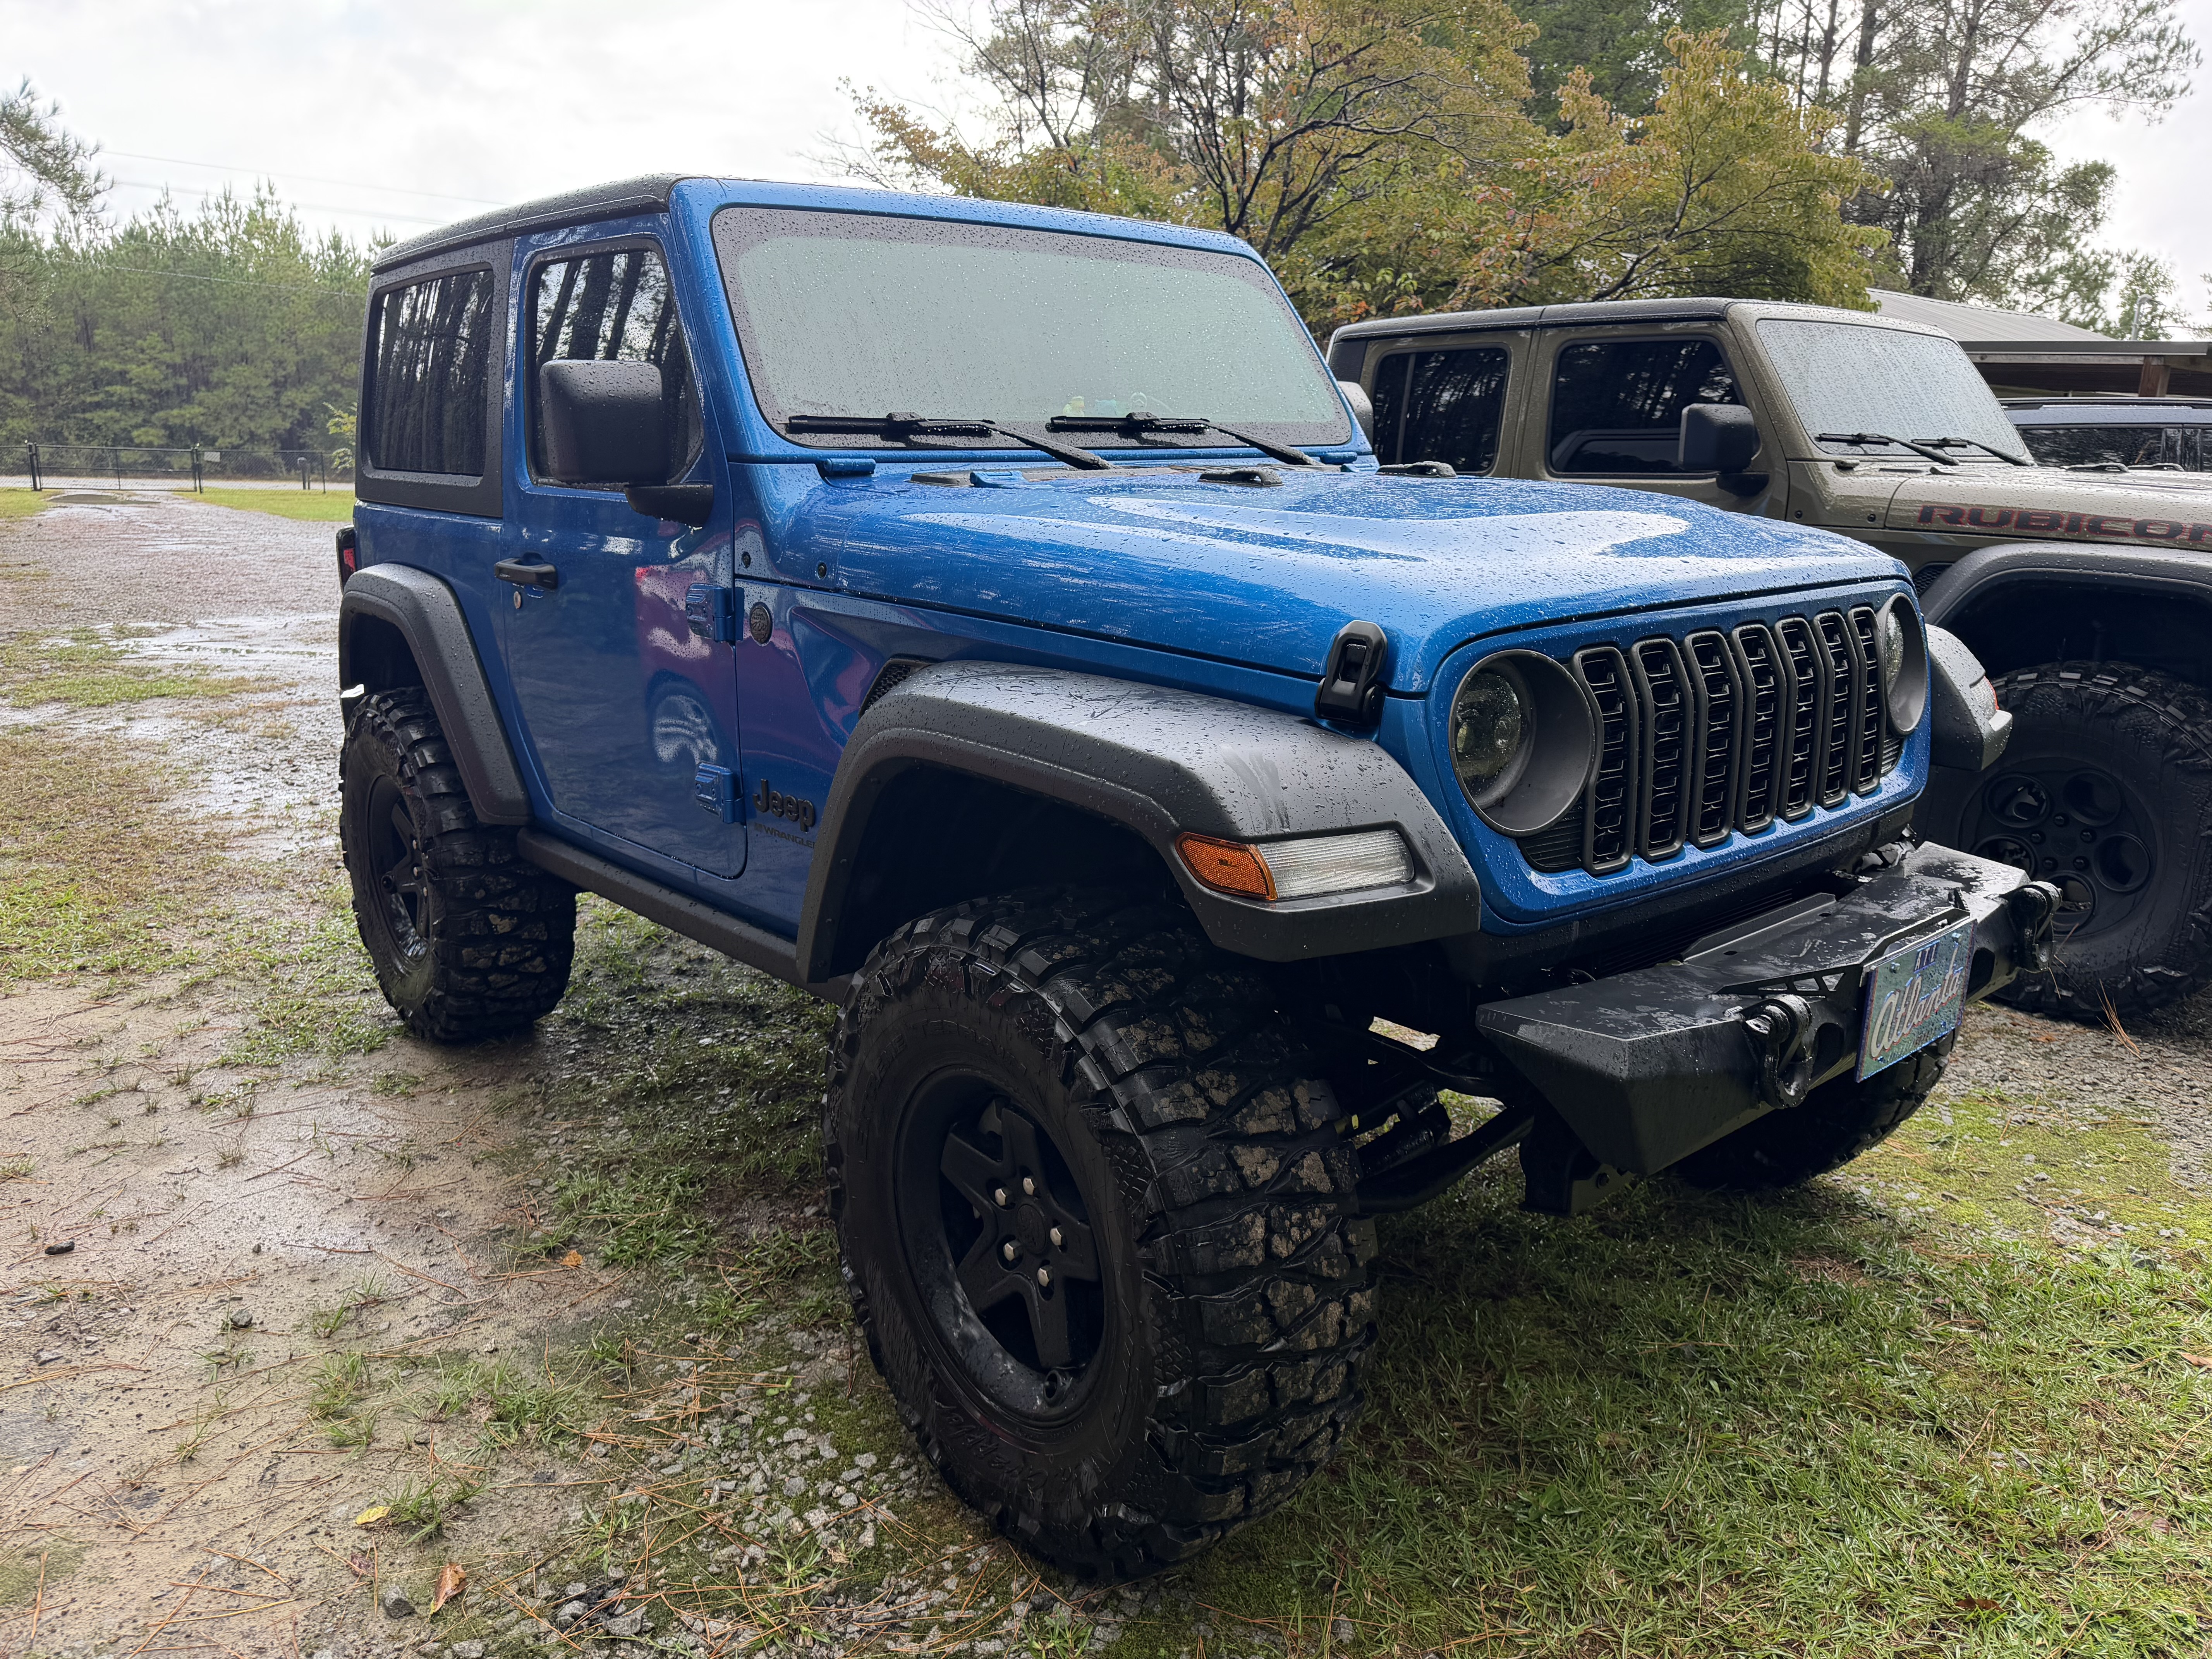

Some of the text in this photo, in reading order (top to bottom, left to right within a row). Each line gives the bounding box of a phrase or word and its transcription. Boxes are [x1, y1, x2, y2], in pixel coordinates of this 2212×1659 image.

[753, 778, 815, 833] Jeep
[1915, 943, 1937, 970] ATL
[1871, 942, 1965, 1059] Atlanta
